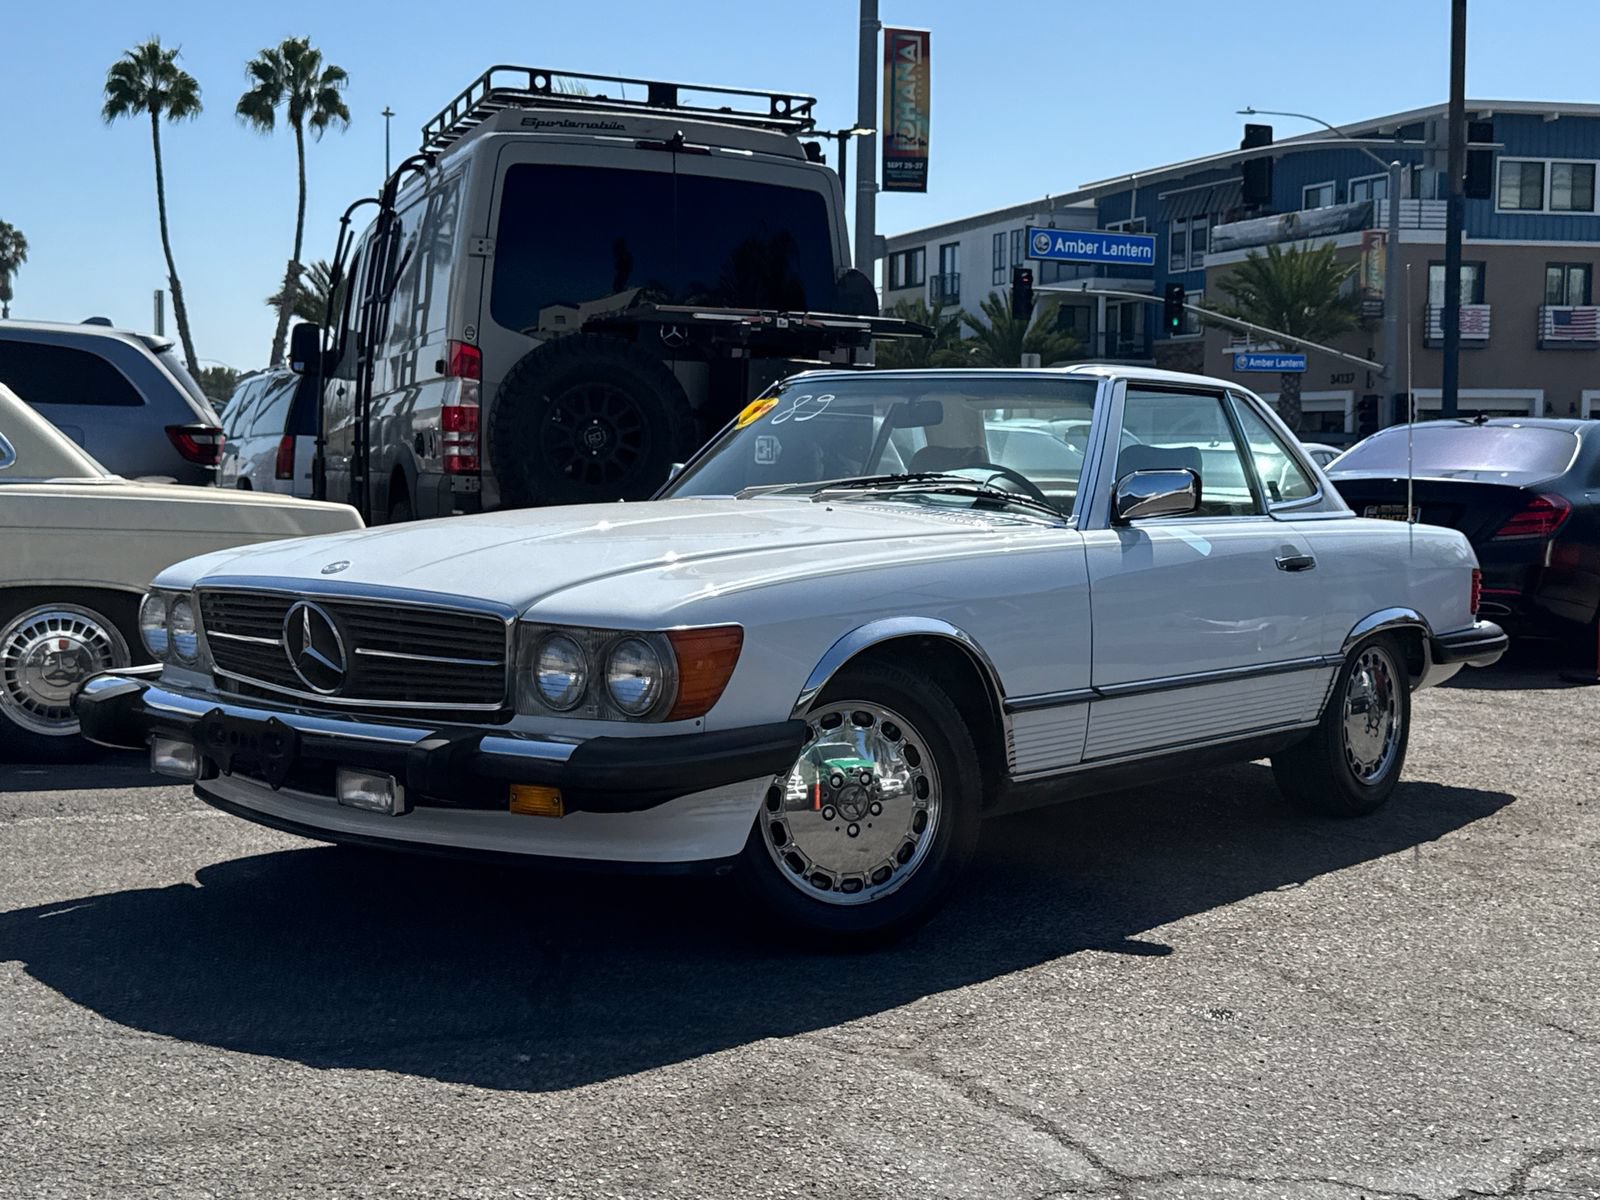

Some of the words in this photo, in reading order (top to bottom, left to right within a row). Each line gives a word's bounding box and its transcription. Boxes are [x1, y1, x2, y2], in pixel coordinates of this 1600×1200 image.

[896, 43, 916, 139] OHANA
[520, 117, 626, 131] Sportsmobile
[887, 161, 903, 169] SEPT
[1055, 238, 1099, 254] Amber
[1102, 240, 1151, 258] Lantern
[1248, 357, 1275, 368] Amber
[1275, 358, 1304, 368] Lantern
[771, 394, 835, 425] 89
